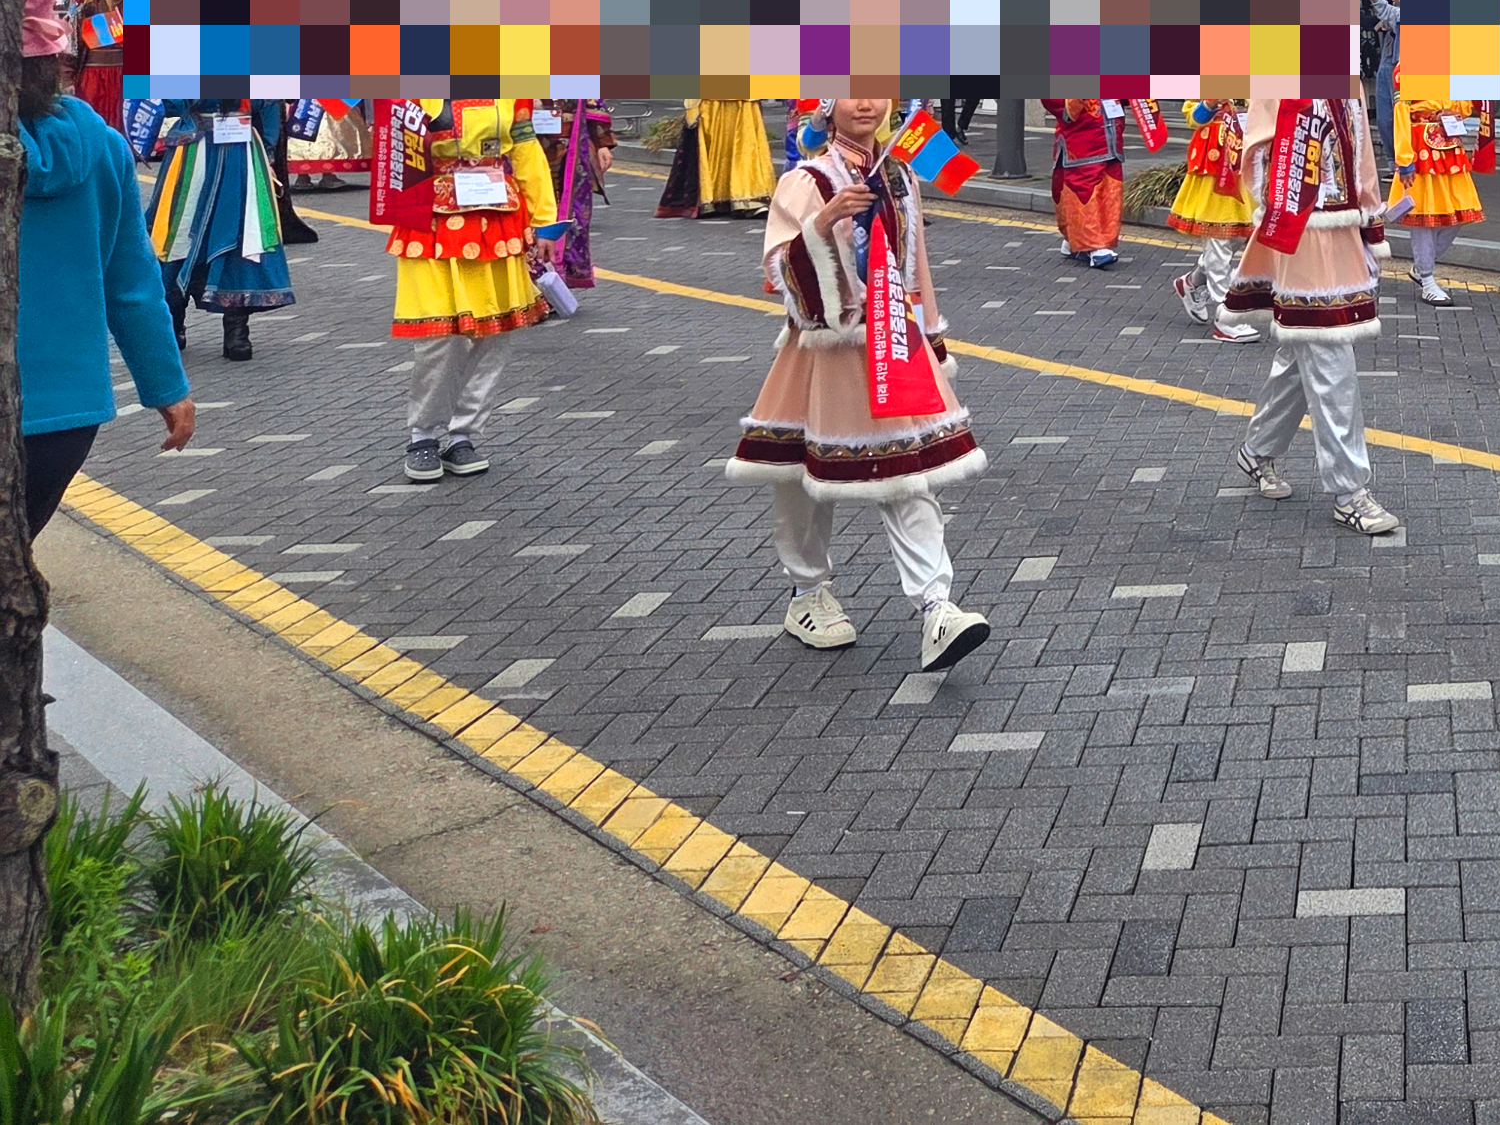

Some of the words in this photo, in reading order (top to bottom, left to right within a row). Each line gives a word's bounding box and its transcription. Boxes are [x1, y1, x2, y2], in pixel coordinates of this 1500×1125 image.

[390, 104, 405, 192] 제2중앙경찰학교
[1286, 113, 1310, 216] 제2중앙경찰학교
[873, 290, 885, 320] 양성의
[874, 319, 887, 361] 핵심인재
[876, 362, 888, 382] 치안
[877, 384, 889, 404] 미래
